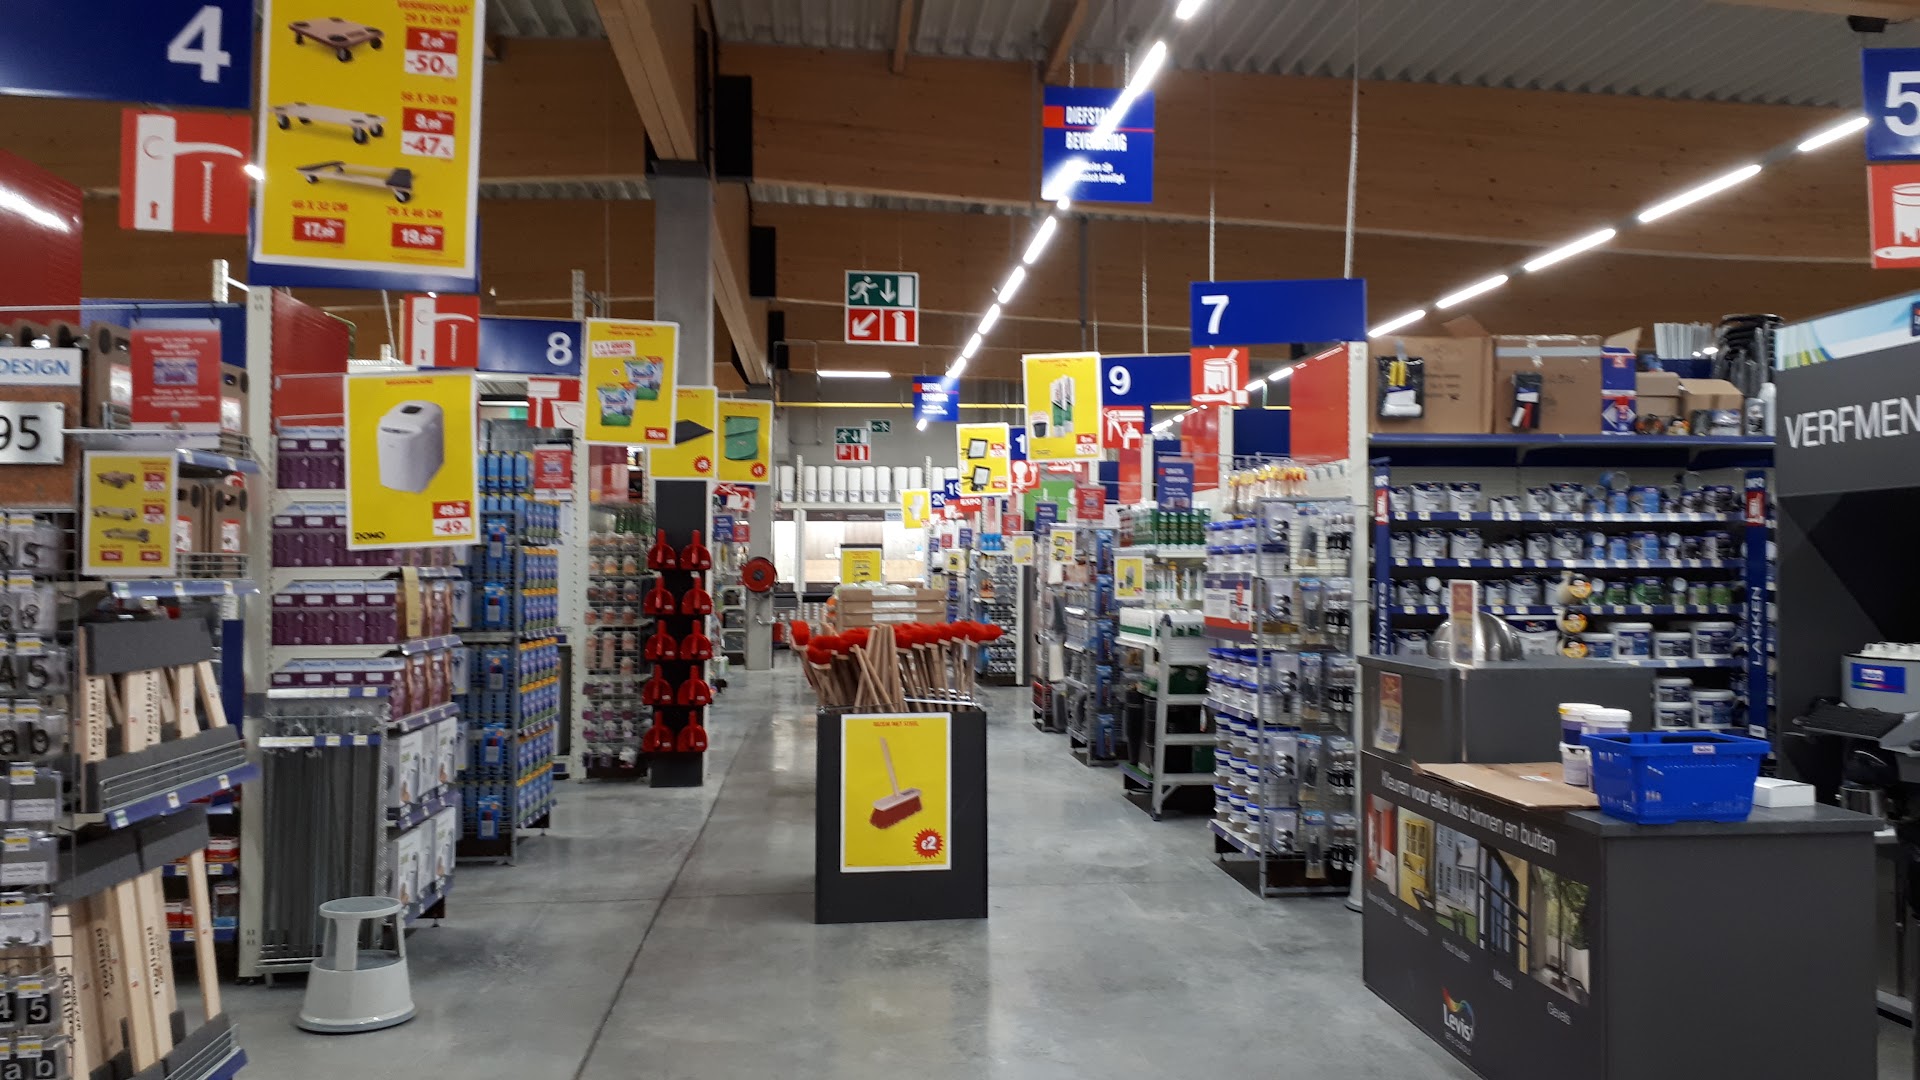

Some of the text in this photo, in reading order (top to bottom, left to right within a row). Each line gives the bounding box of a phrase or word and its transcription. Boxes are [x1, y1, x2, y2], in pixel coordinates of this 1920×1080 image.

[168, 6, 230, 83] 4
[1884, 70, 1920, 137] 5
[1202, 295, 1229, 334] 7
[547, 332, 573, 366] 8
[1109, 365, 1131, 395] 9
[1381, 769, 1411, 797] Kleuren
[1469, 803, 1504, 836] binnen
[1504, 820, 1520, 842] en
[1520, 822, 1557, 857] buiten
[30, 998, 48, 1021] 5
[5, 1063, 22, 1080] a
[36, 1057, 54, 1077] b
